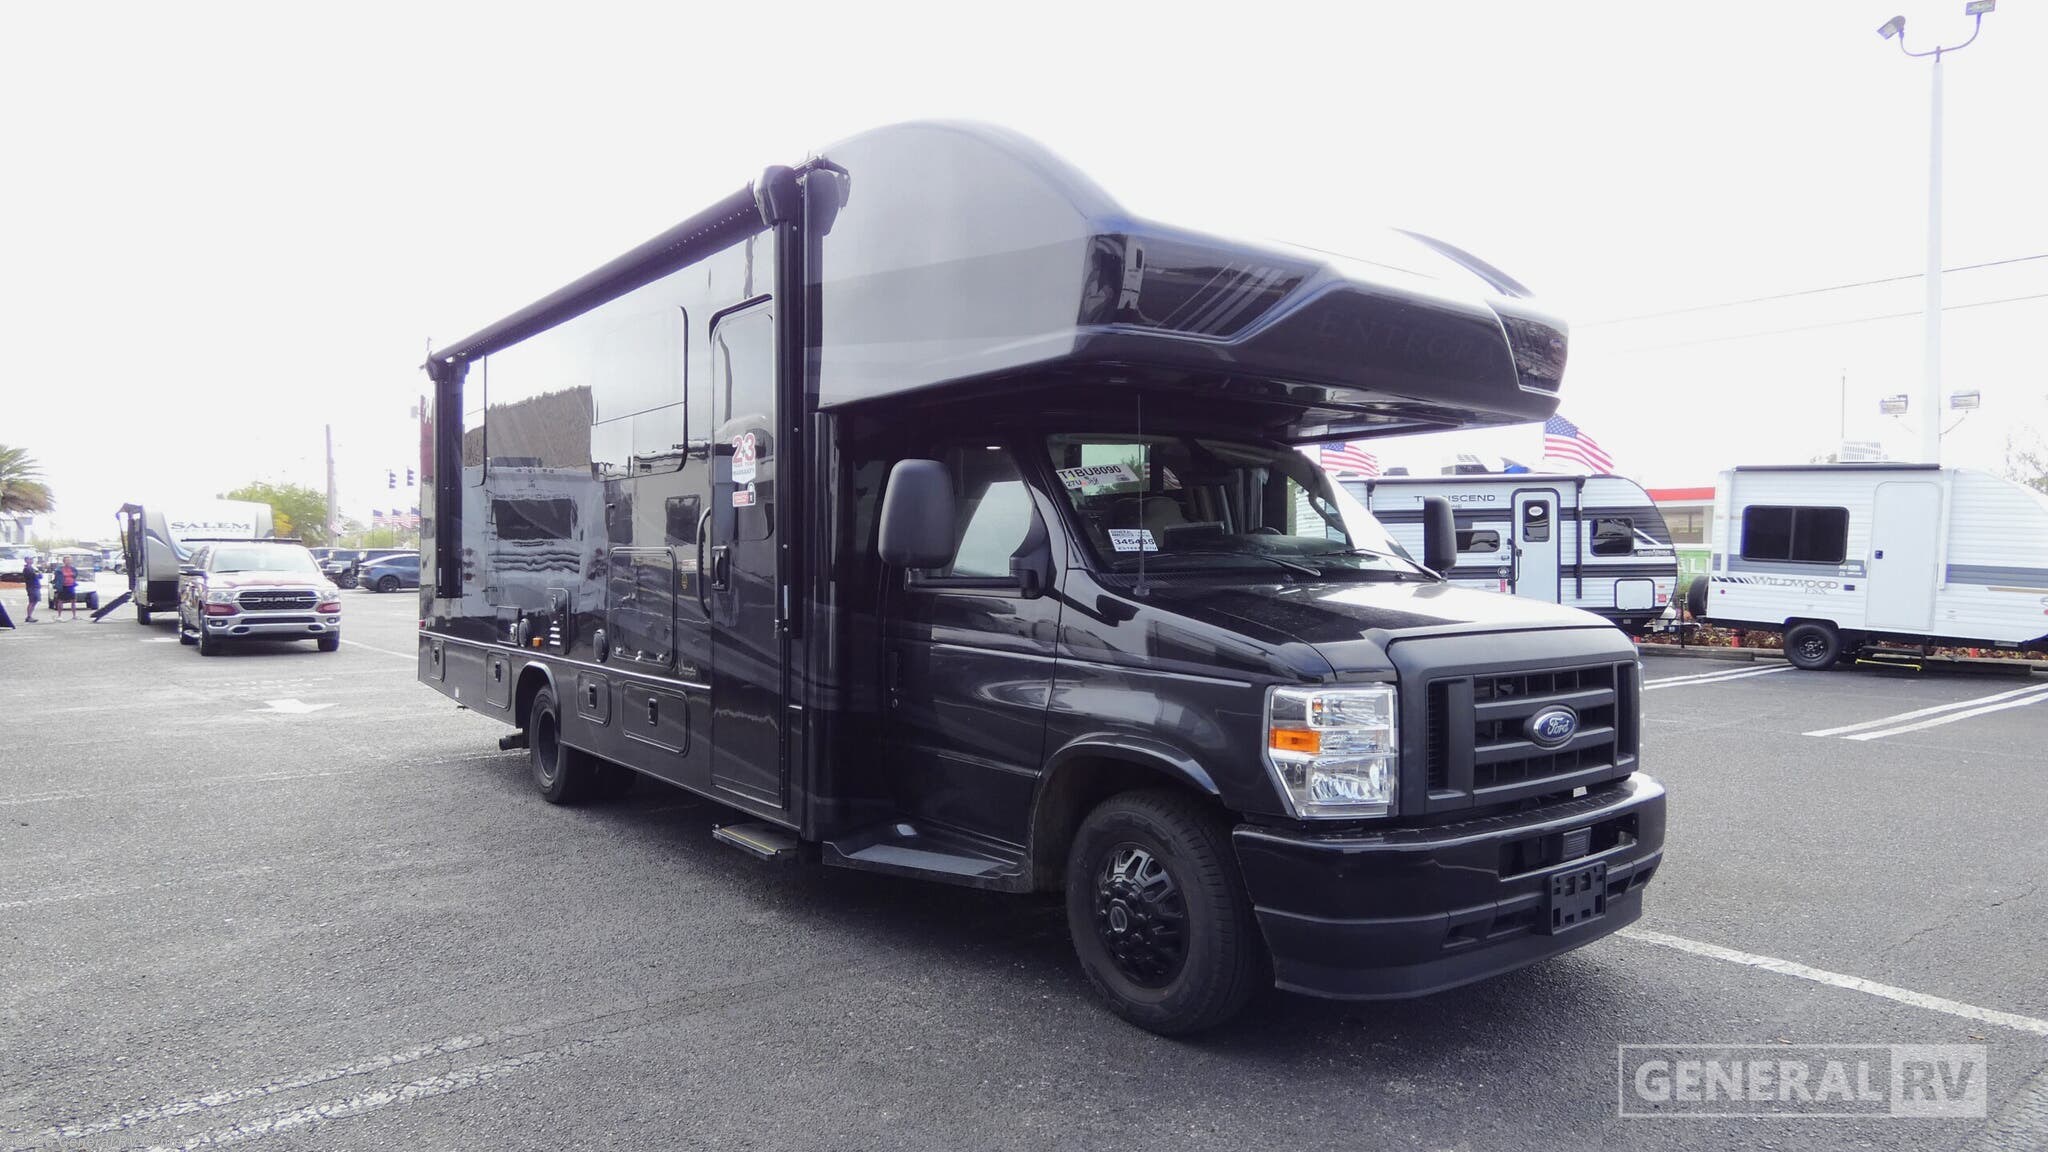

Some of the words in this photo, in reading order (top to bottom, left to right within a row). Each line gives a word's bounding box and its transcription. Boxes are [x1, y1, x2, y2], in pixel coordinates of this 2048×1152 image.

[170, 521, 251, 530] SALEM
[1752, 575, 1839, 589] WILDWOOD
[1547, 718, 1569, 735] Ford
